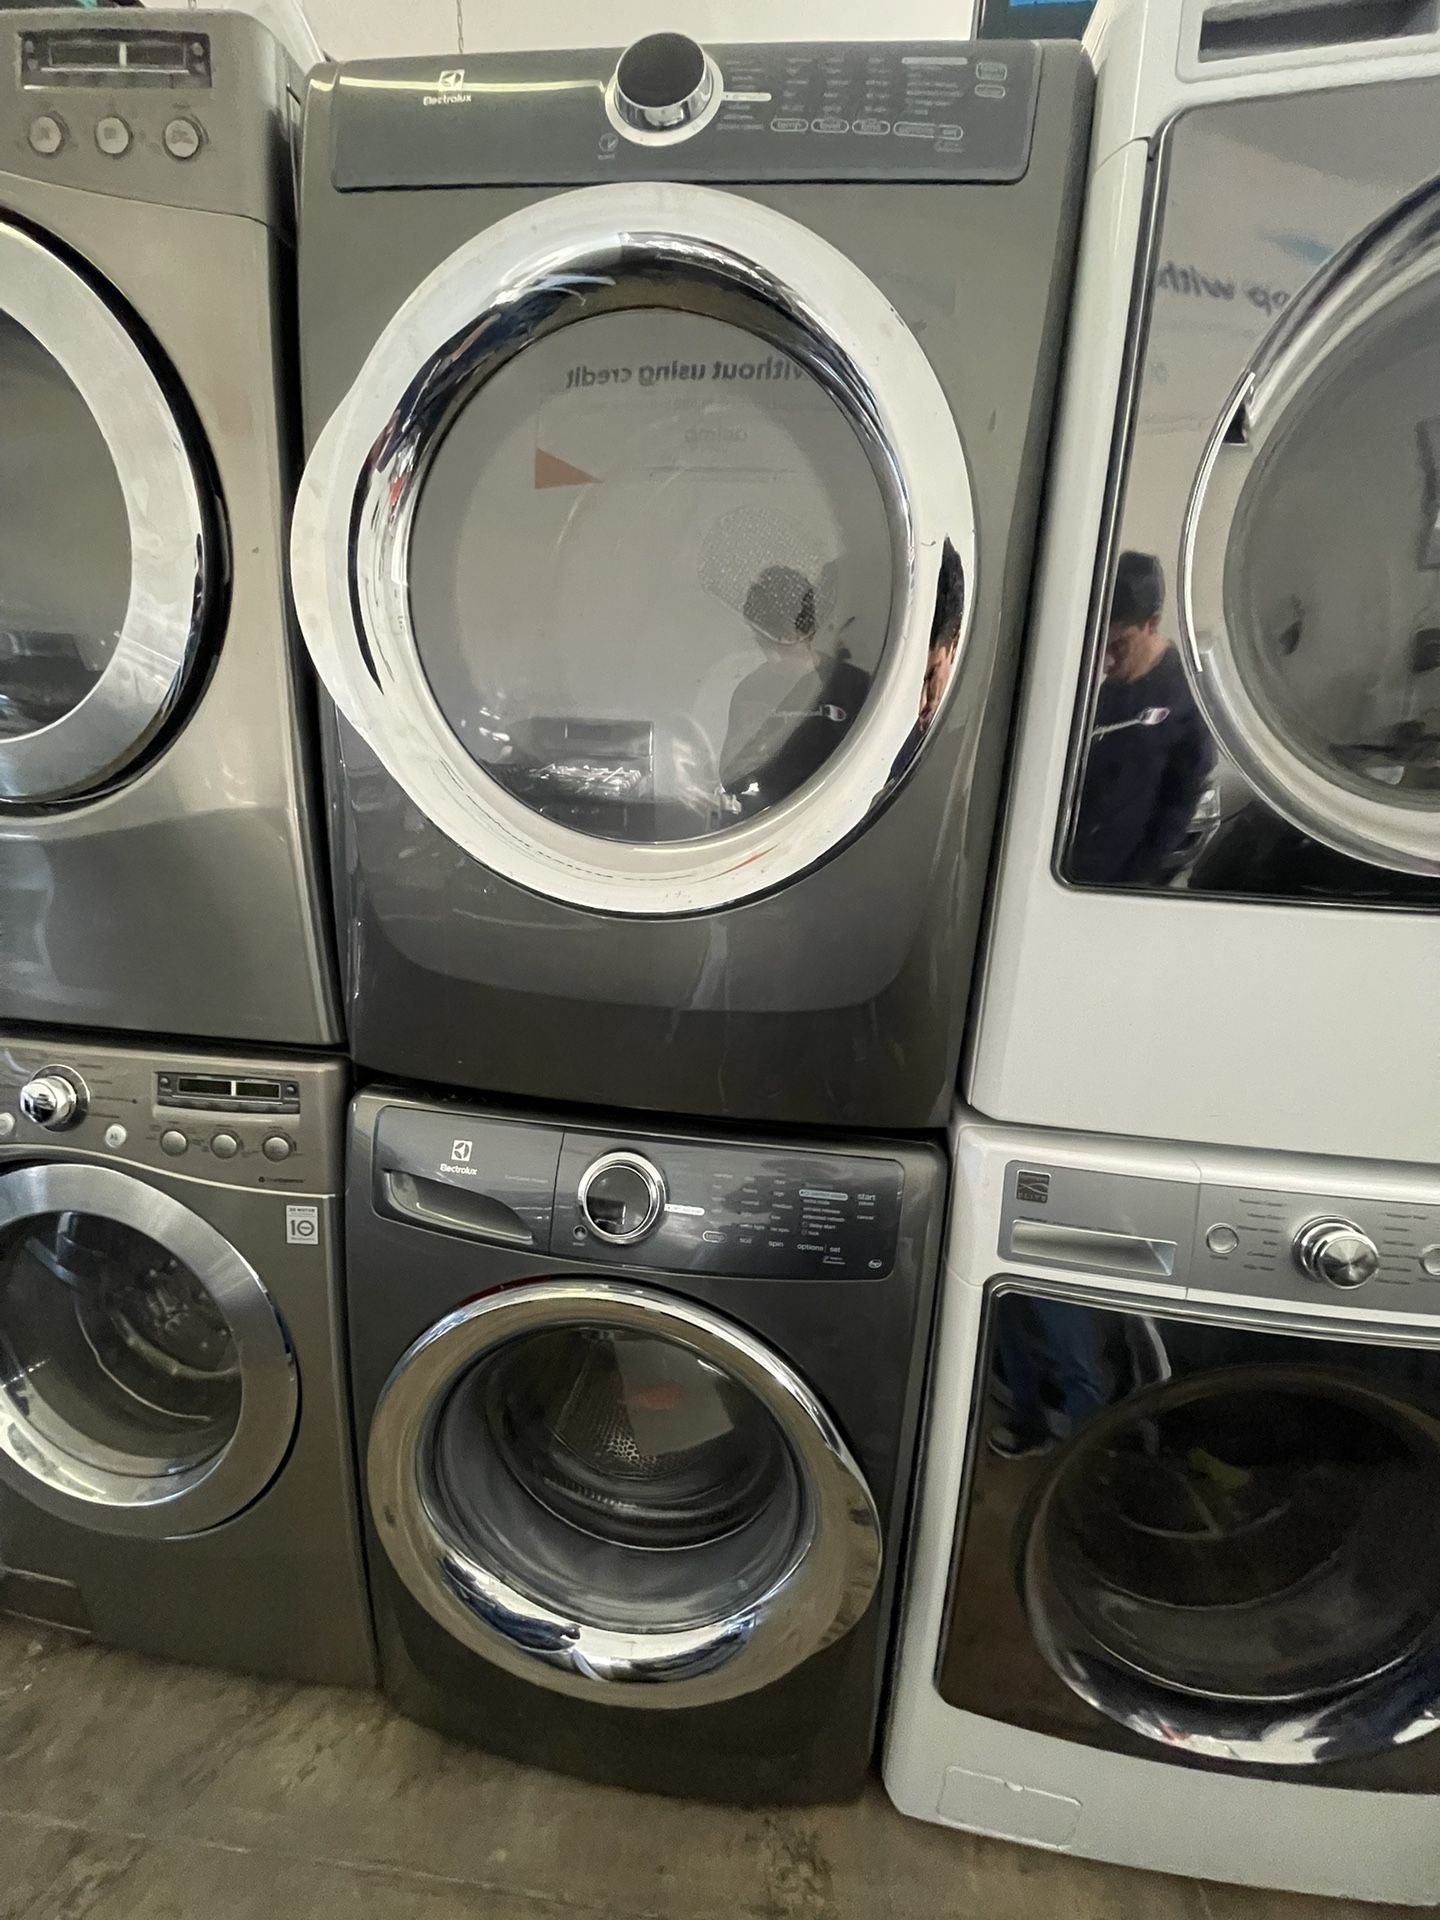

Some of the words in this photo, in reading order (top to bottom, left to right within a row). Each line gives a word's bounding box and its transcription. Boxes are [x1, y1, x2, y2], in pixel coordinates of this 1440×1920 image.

[423, 94, 471, 106] Electrolux
[440, 1163, 477, 1175] Electrolux
[857, 1193, 876, 1201] start
[797, 1243, 824, 1252] options
